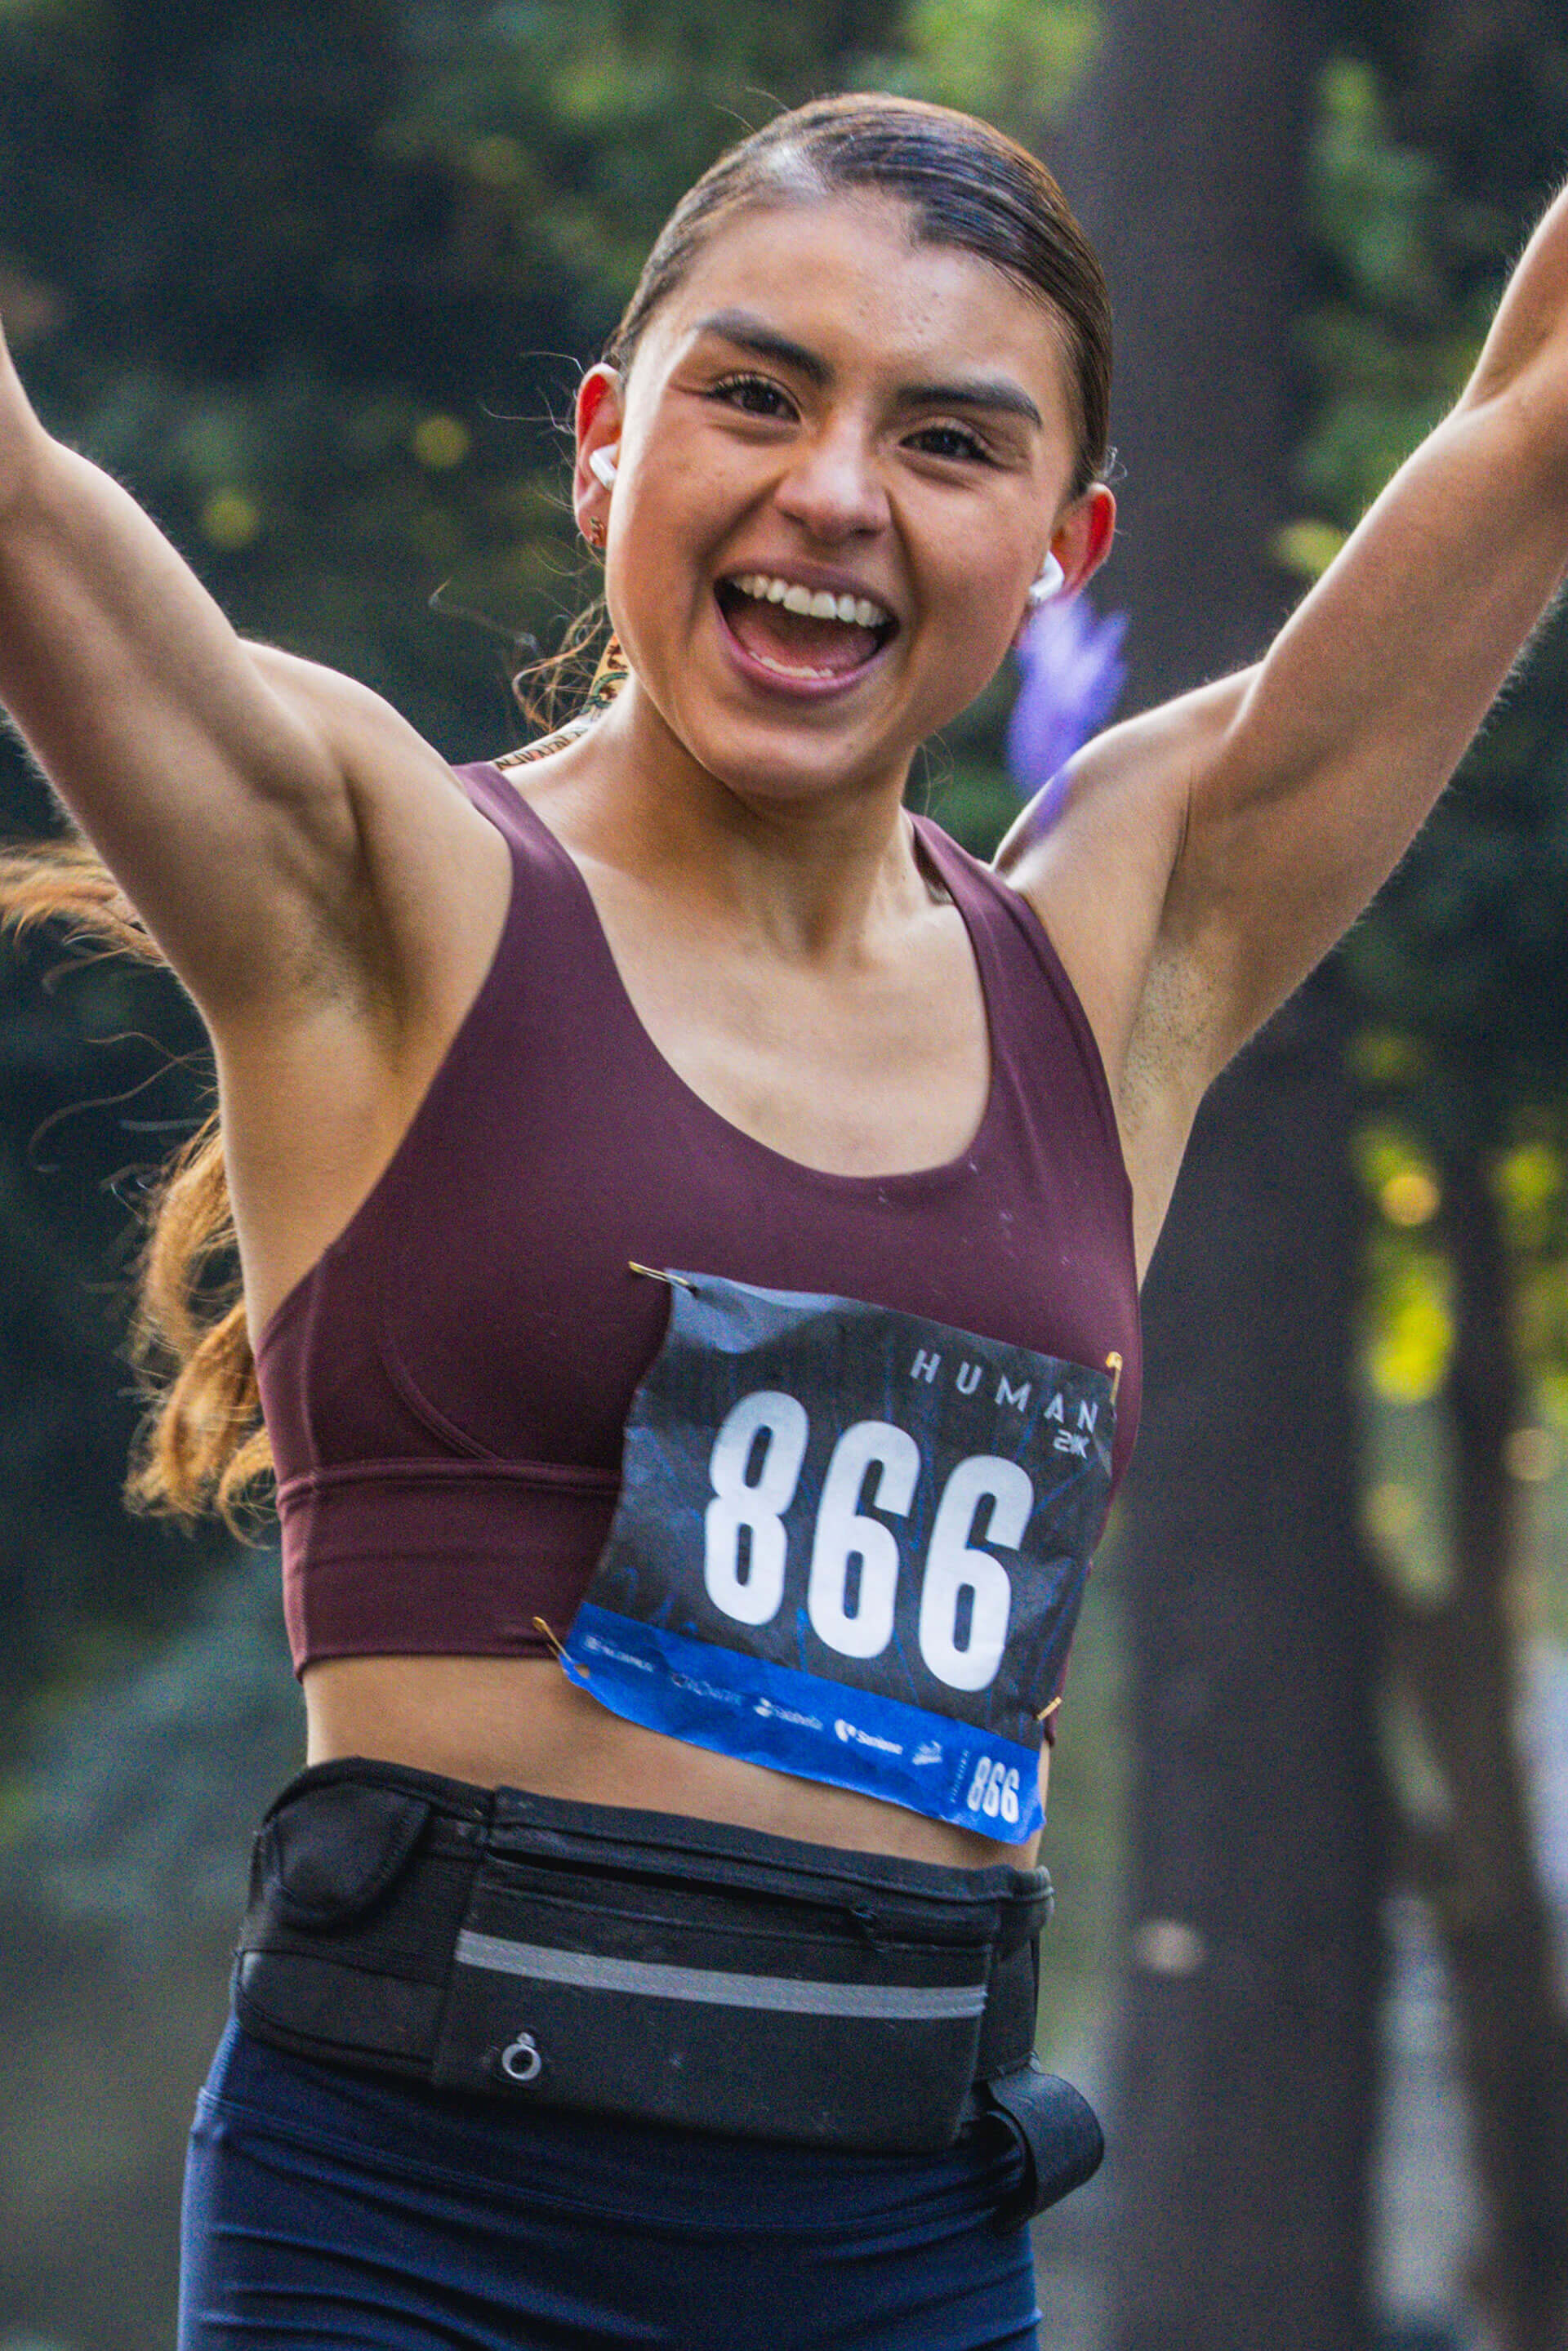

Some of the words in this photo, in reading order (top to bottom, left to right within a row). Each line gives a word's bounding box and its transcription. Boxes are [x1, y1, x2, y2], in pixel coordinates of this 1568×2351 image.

[909, 1348, 1098, 1434] HUMAN
[703, 1389, 1036, 1692] 866
[966, 1755, 1020, 1823] 866
